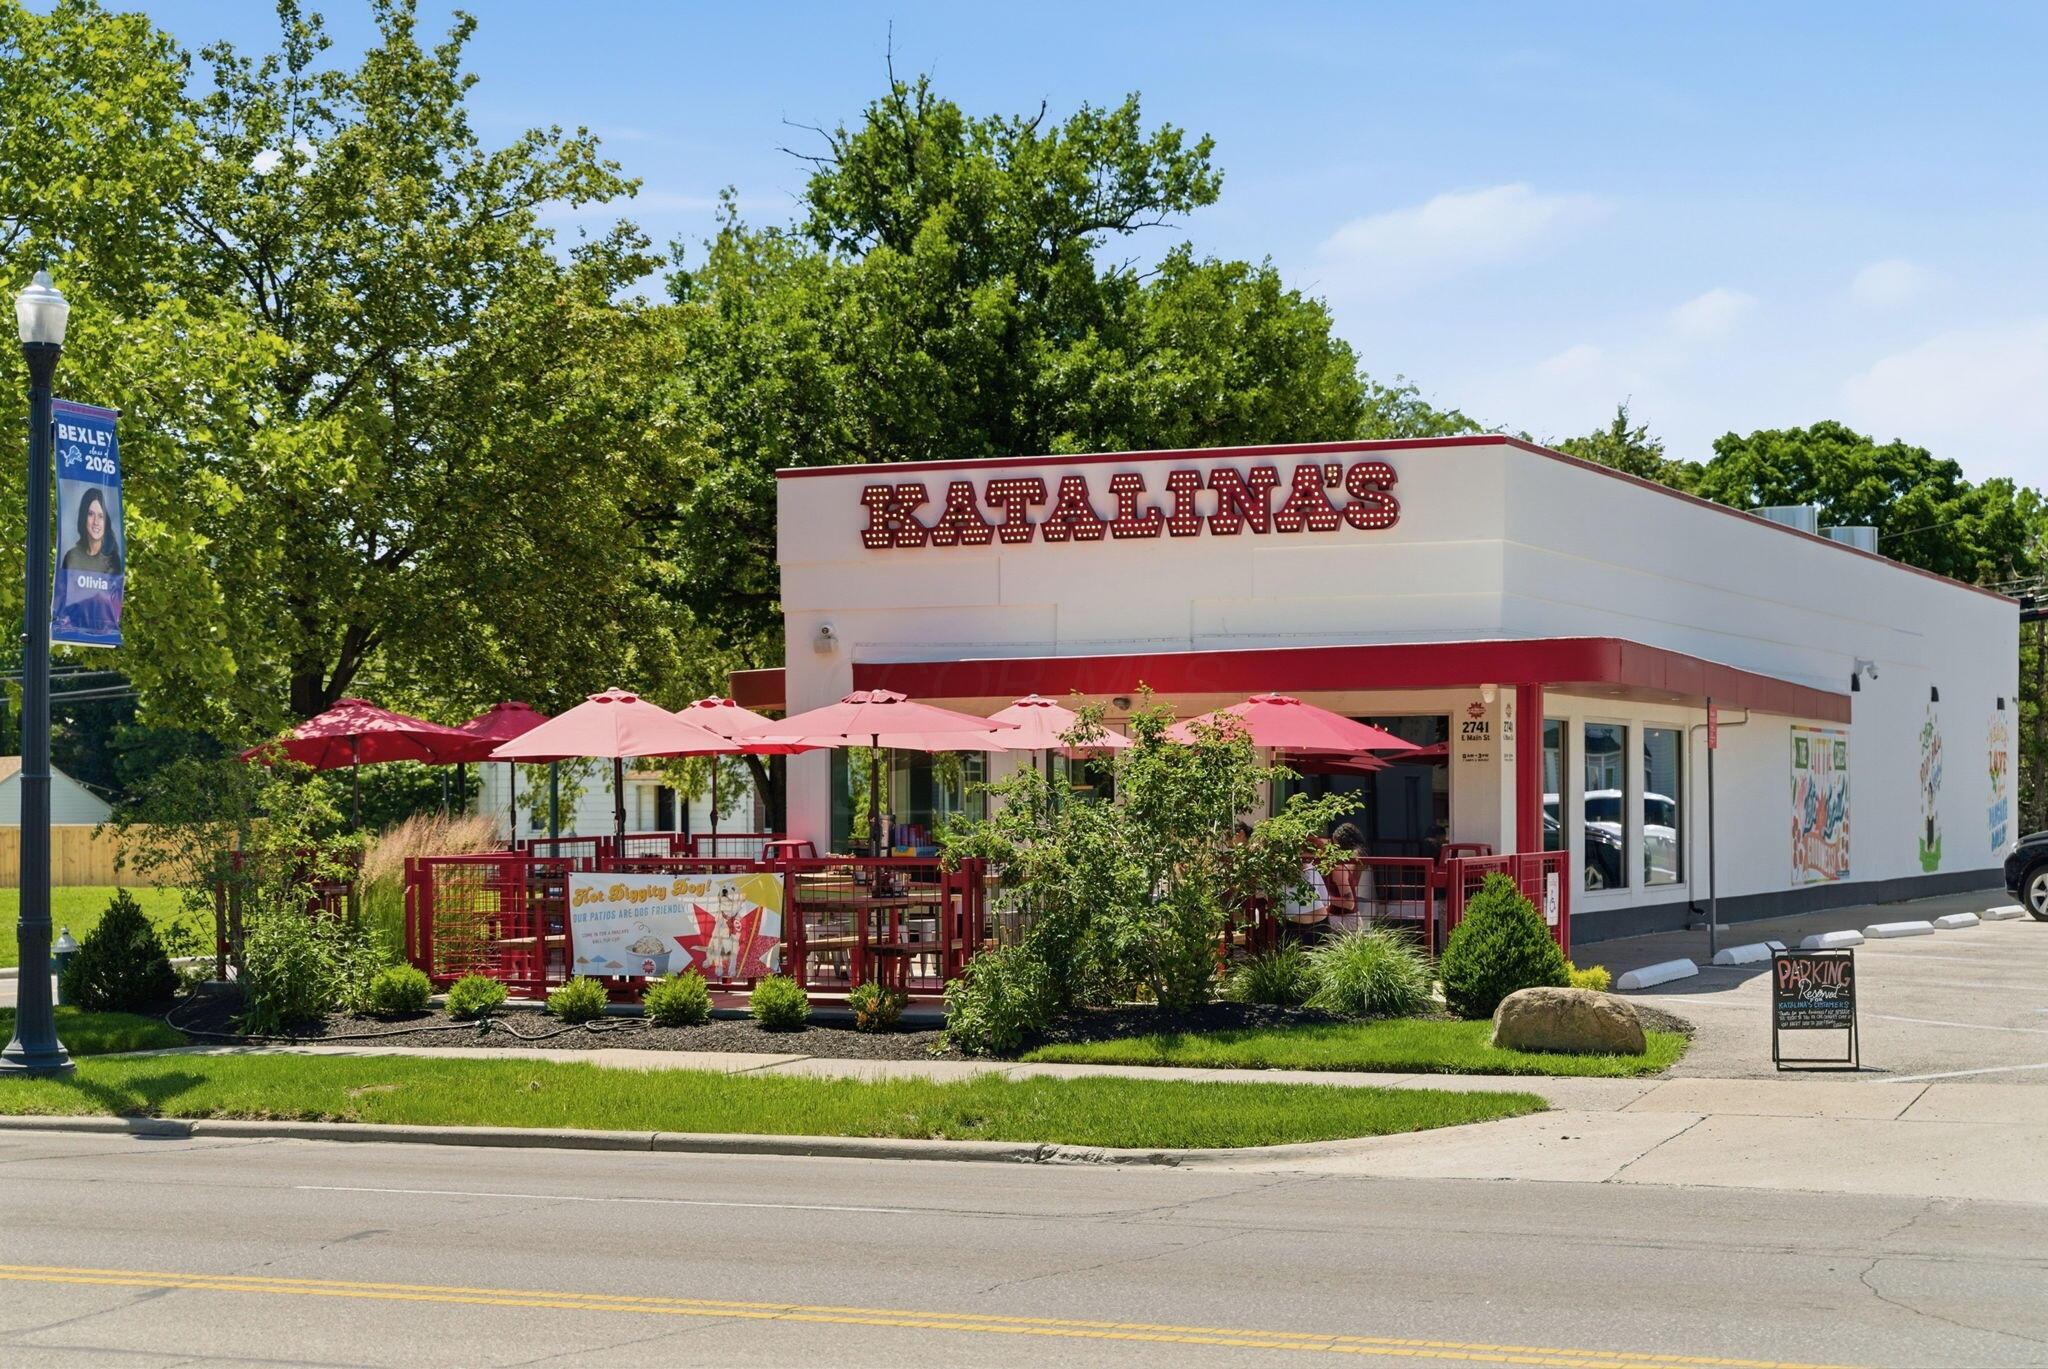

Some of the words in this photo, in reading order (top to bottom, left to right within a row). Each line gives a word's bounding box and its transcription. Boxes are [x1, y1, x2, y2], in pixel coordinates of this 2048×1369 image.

[58, 424, 113, 447] BEXLEY
[85, 455, 116, 475] 2026
[861, 462, 1400, 549] KATALINA'S
[77, 575, 109, 590] Olivia
[1462, 721, 1489, 733] 2741
[572, 886, 605, 907] Hot
[608, 881, 667, 904] Diggity
[672, 878, 712, 897] Dog!
[573, 913, 588, 923] OUR
[590, 910, 616, 921] PATIOS
[618, 908, 632, 919] ARE
[635, 907, 649, 917] DOG
[1777, 960, 1851, 989] PARKING
[1798, 978, 1841, 999] Reserved
